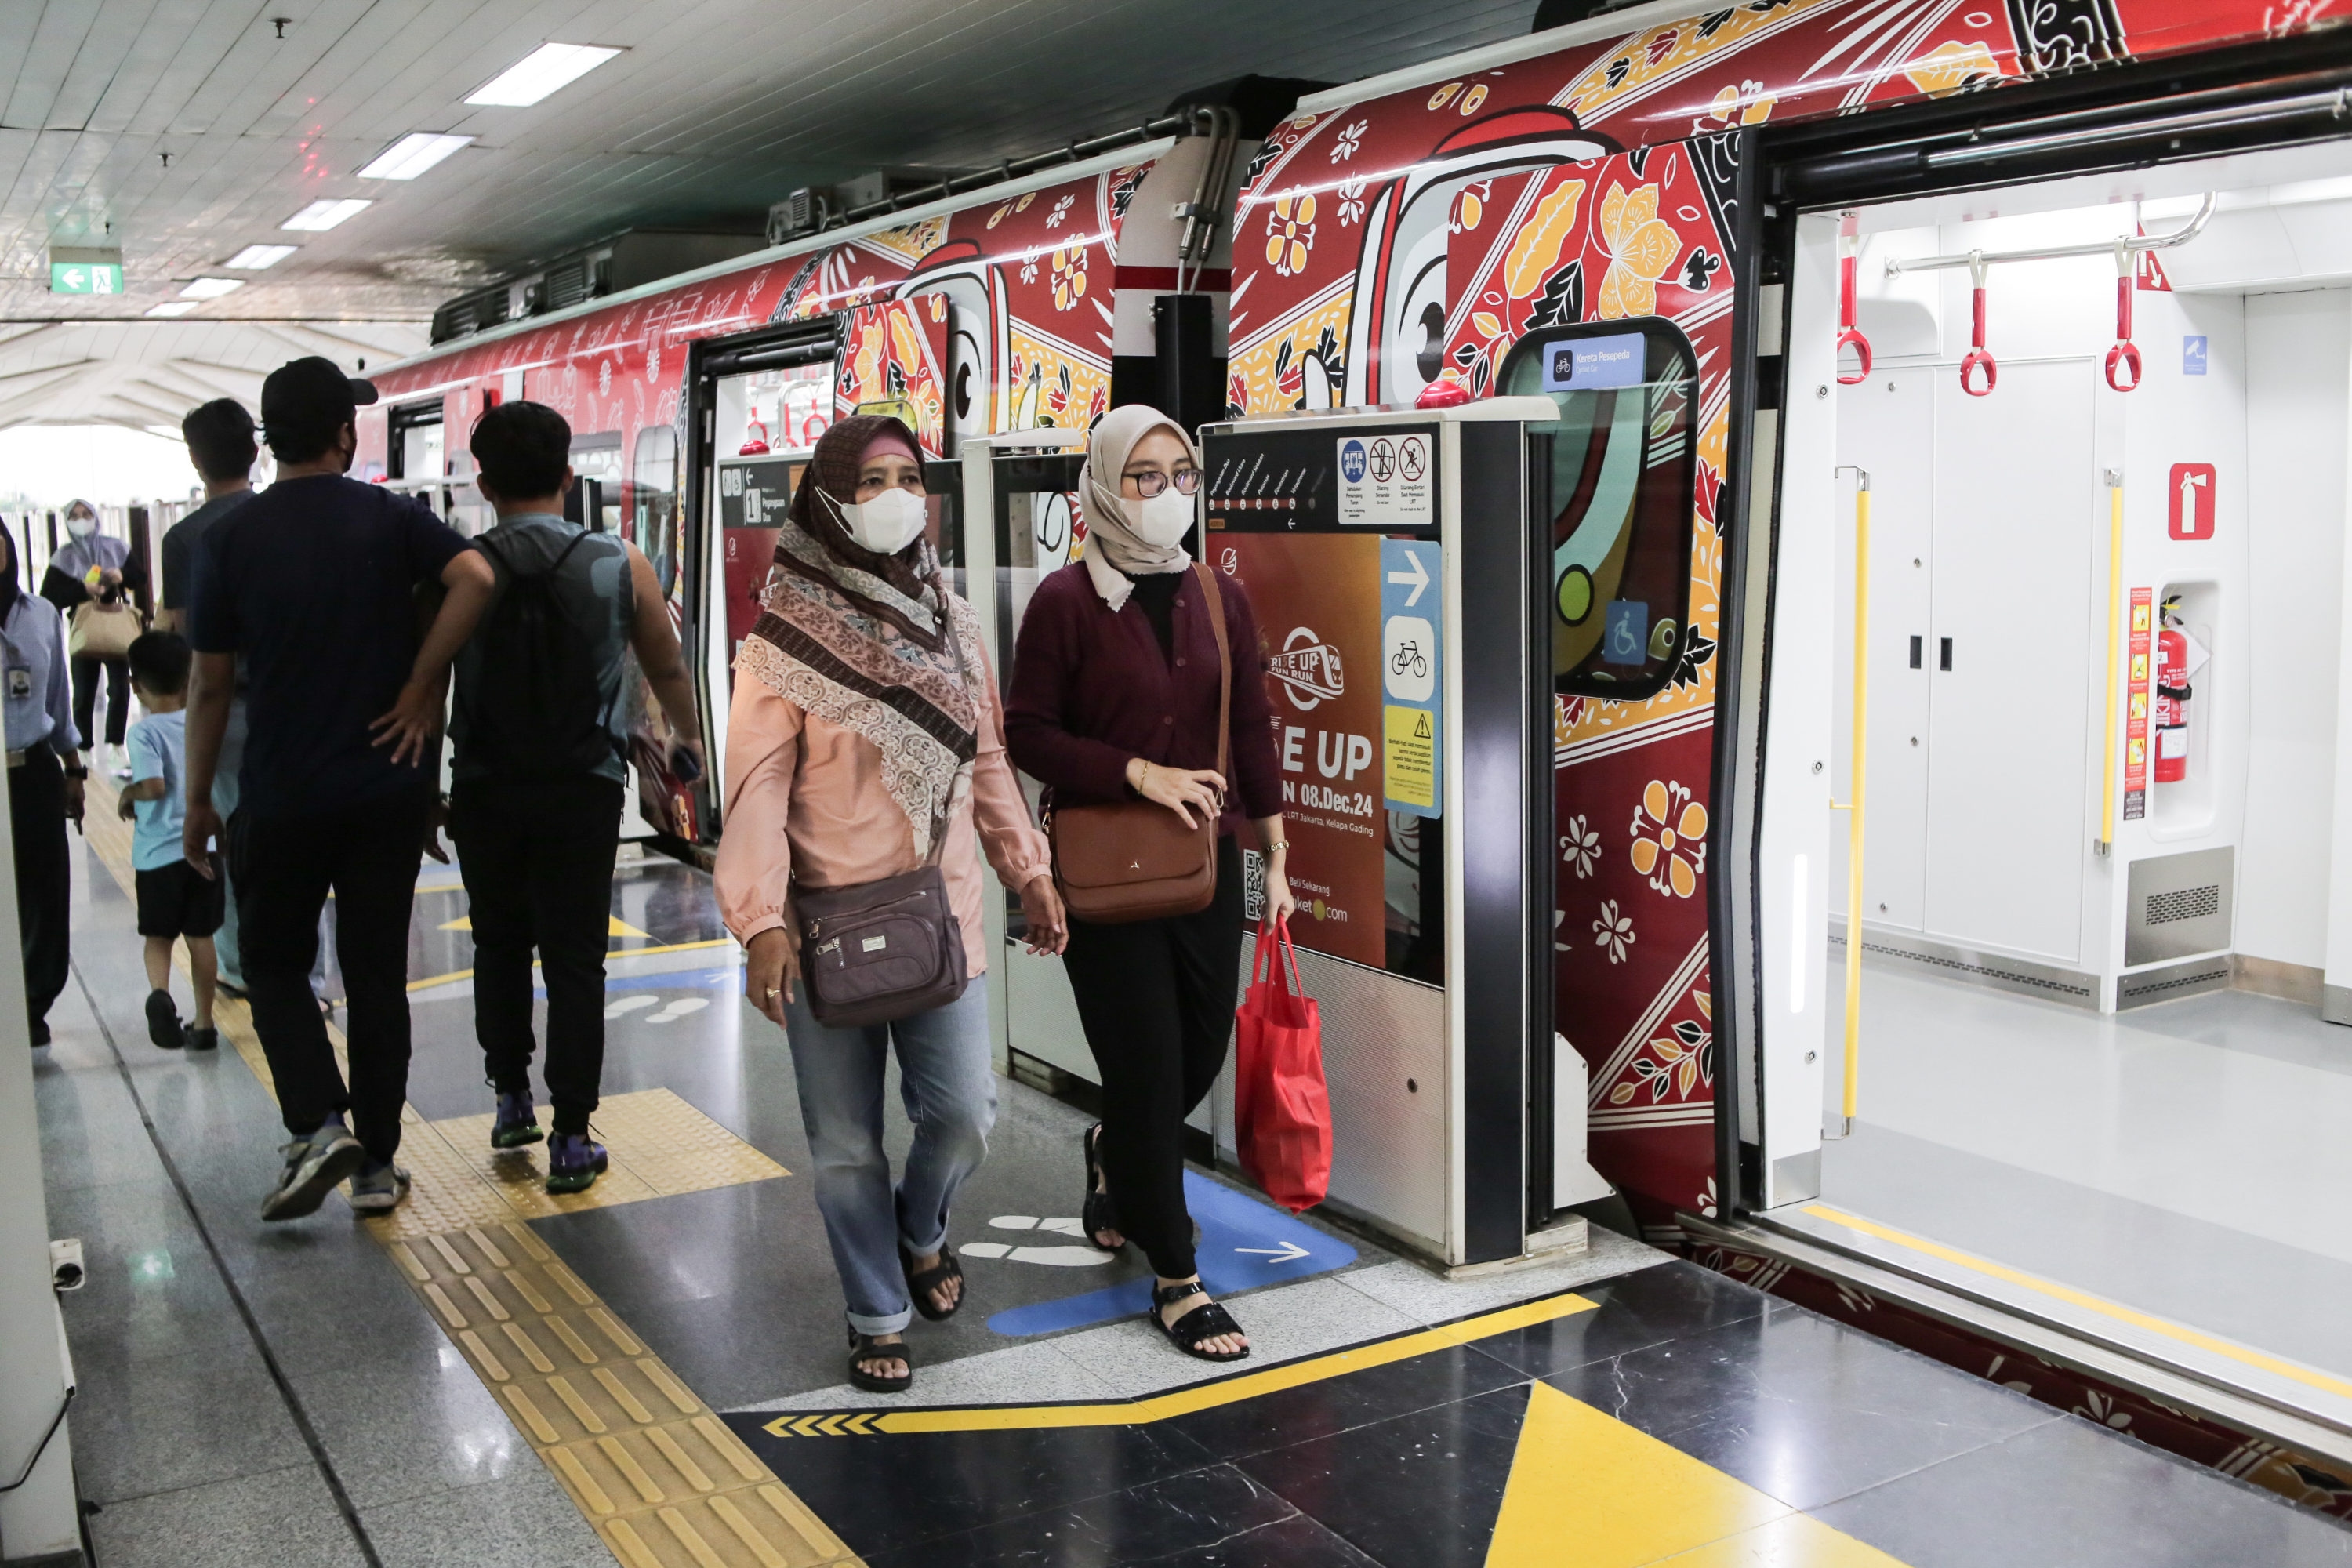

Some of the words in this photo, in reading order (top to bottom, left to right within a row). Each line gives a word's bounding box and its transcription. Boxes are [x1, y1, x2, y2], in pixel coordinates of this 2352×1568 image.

[1576, 353, 1598, 363] Kereta
[1599, 349, 1631, 362] Pesepeda
[1299, 652, 1321, 672] UP
[1271, 666, 1289, 676] FUN
[1291, 670, 1315, 683] RUN
[1317, 730, 1373, 781] UP
[1301, 783, 1374, 818] 08.Dec.24
[1287, 811, 1299, 820] LRT
[1300, 813, 1325, 826] Jakarta,
[1326, 818, 1348, 831] Kelapa
[1349, 823, 1374, 837] Gading
[1290, 877, 1301, 887] Beli
[1301, 880, 1330, 897] Sekarang
